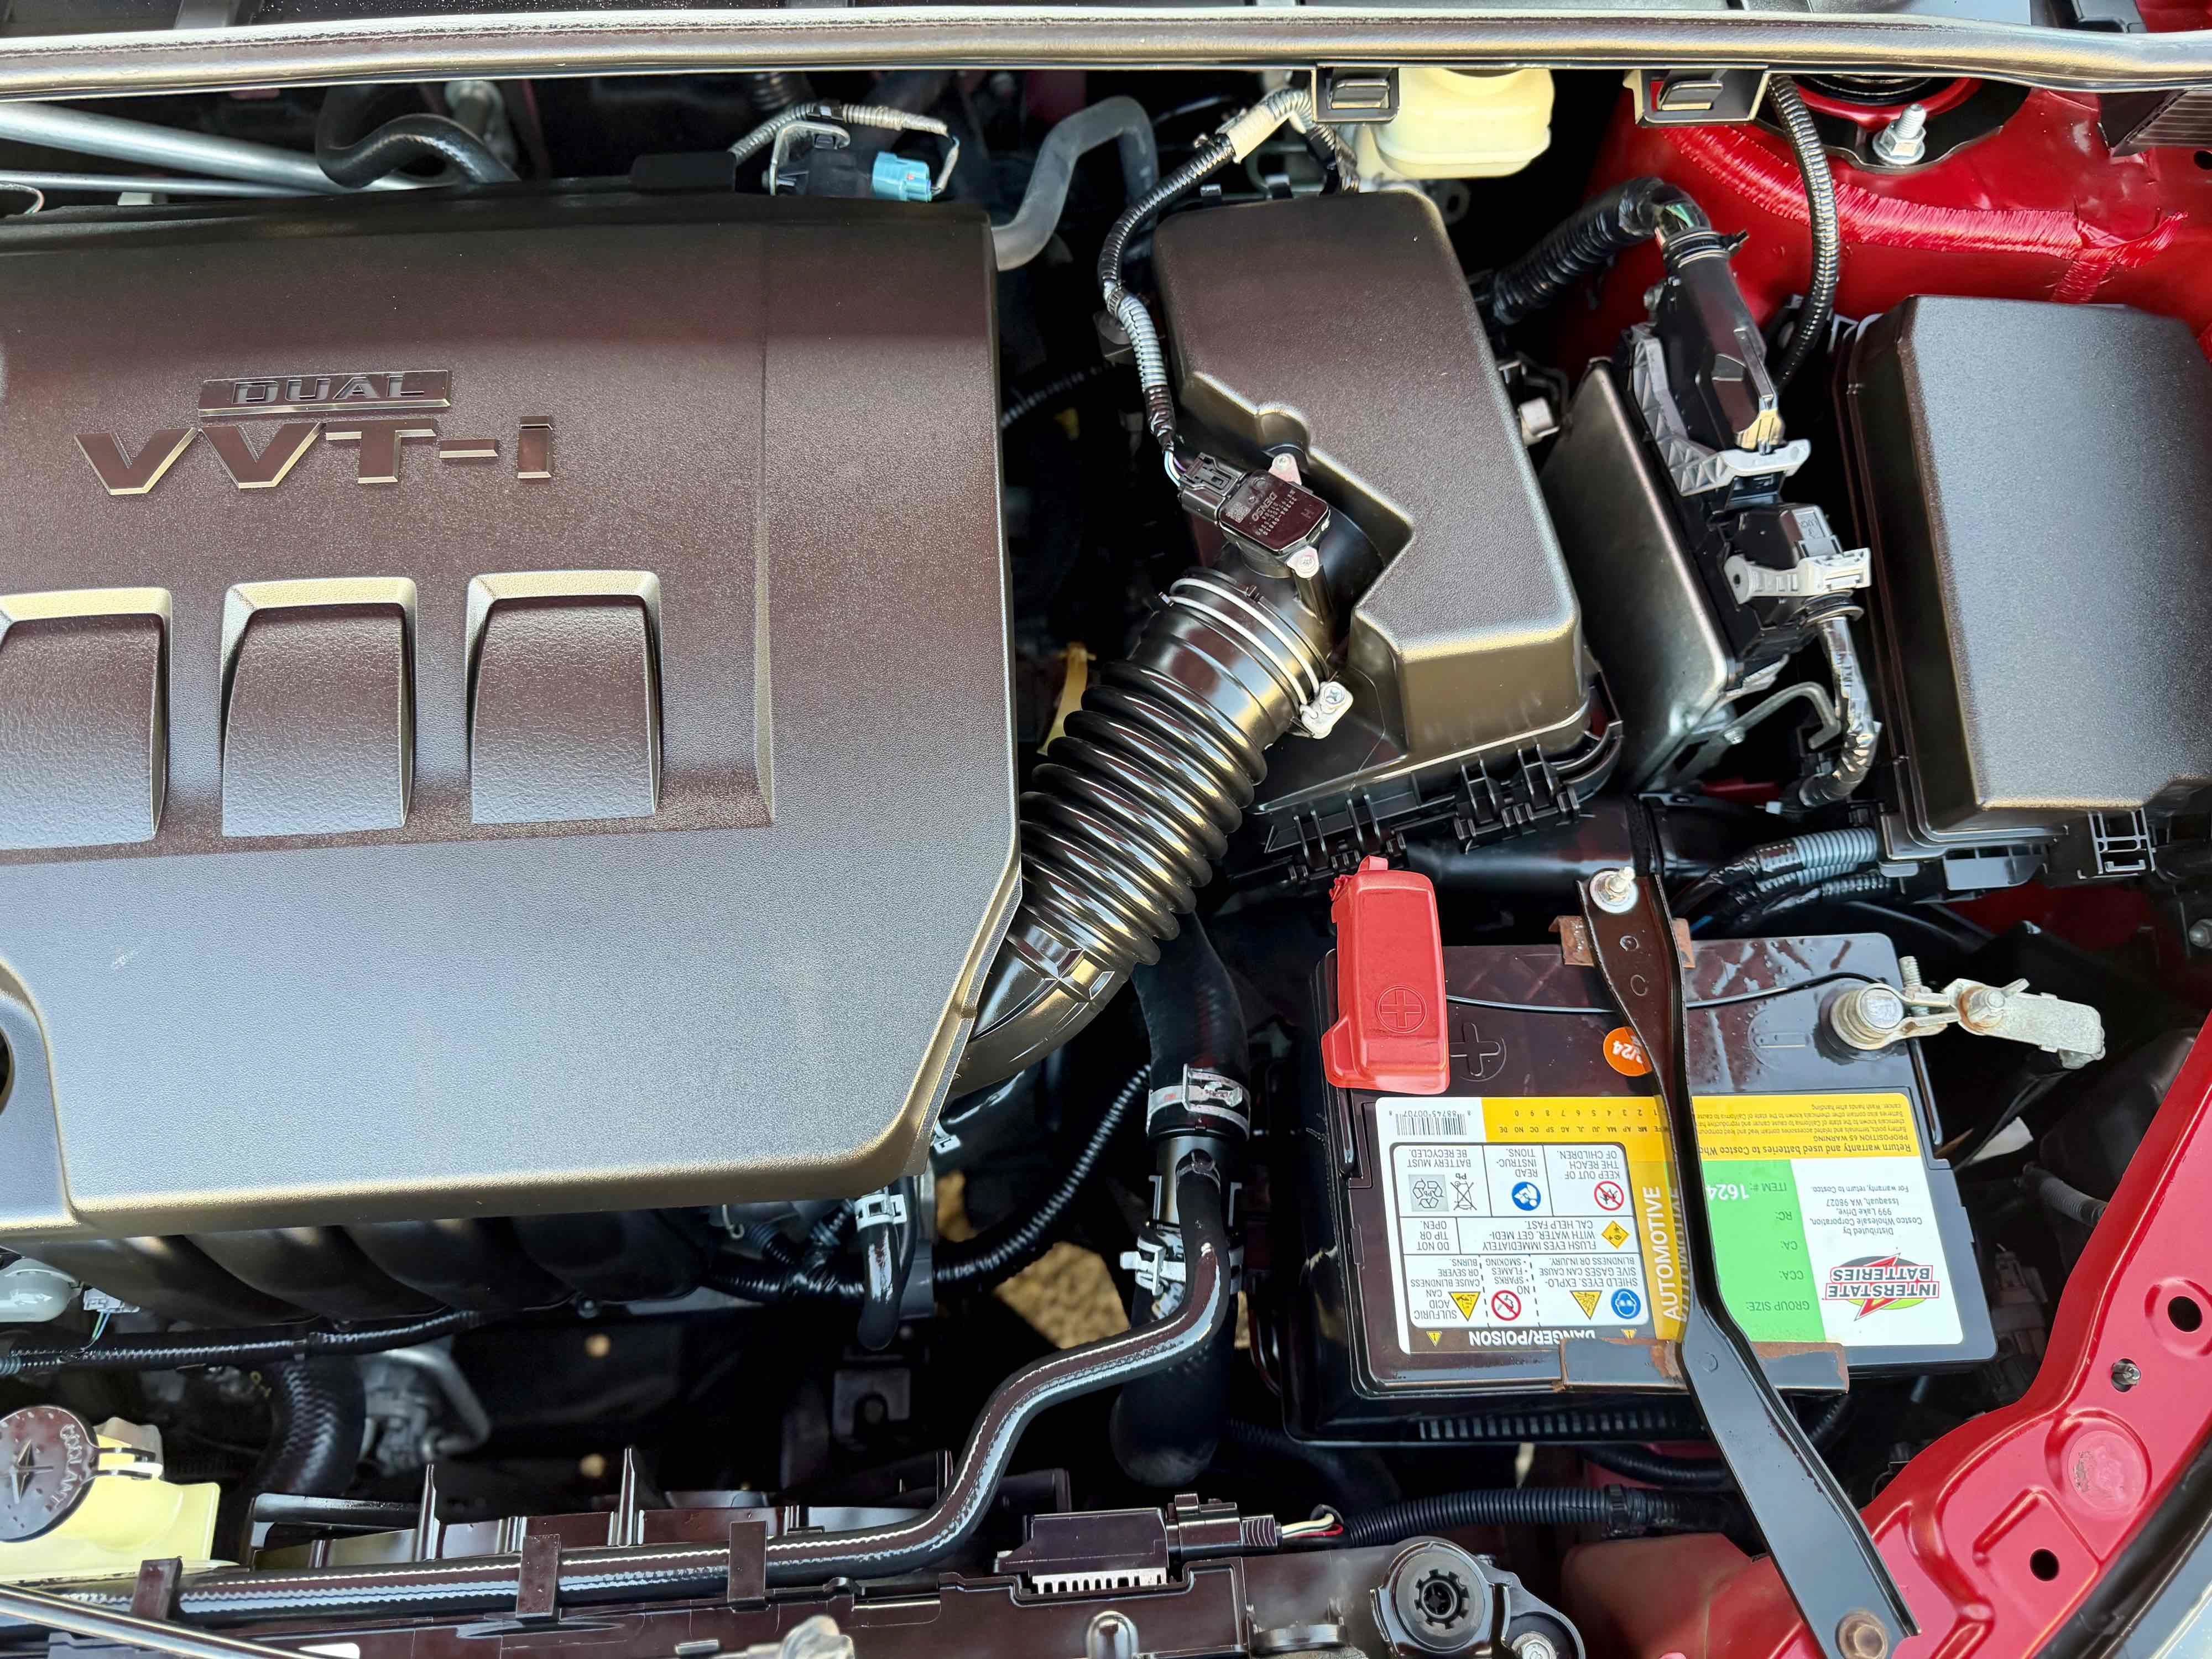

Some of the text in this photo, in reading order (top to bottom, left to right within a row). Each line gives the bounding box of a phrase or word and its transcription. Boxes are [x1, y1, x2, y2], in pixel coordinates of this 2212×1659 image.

[232, 374, 424, 404] DUAL
[1252, 491, 1277, 521] DENSO
[1720, 1146, 1749, 1155] Costco
[1763, 1146, 1801, 1155] batteries
[1803, 1146, 1823, 1155] used
[1825, 1146, 1840, 1154] and
[1844, 1143, 1880, 1152] warranty
[1882, 1144, 1911, 1152] Return
[1408, 1149, 1467, 1158] BE RECYCLED.
[1506, 1149, 1535, 1157] TIONS.
[1557, 1150, 1617, 1159] OF CHILDREN.
[1407, 1159, 1471, 1167] BATTERY MUST
[1496, 1159, 1536, 1167] INSTRUC-
[1569, 1160, 1618, 1169] THE REACH
[1515, 1169, 1538, 1177] READ
[1578, 1171, 1596, 1179] OUT
[1598, 1170, 1620, 1179] KEEP
[1749, 1182, 1759, 1191] #:
[1761, 1182, 1787, 1191] ITEM
[1775, 1211, 1792, 1220] RC:
[1836, 1208, 1856, 1216] Drive,
[1420, 1221, 1447, 1229] OPEN.
[1525, 1220, 1593, 1229] CAL HELP FAST.
[1809, 1217, 1855, 1227] Corporation,
[1420, 1231, 1448, 1240] TIP OR
[1489, 1230, 1595, 1240] WITH WATER. GET MEDI-
[1843, 1227, 1851, 1235] by
[1417, 1242, 1449, 1251] DO NOT
[1483, 1241, 1596, 1251] FLUSH EYES IMMEDIATELY
[1780, 1240, 1797, 1250] CA:
[1642, 1186, 1682, 1322] AUTOMOTIVE
[1592, 1256, 1635, 1265] BLINDNESS
[1540, 1267, 1564, 1276] CAUSE
[1585, 1267, 1615, 1276] GASES
[1616, 1266, 1636, 1276] SIVE
[1778, 1271, 1804, 1280] CCA:
[1833, 1267, 1930, 1281] BATTERIES
[1454, 1279, 1480, 1287] CAUSE
[1545, 1278, 1637, 1287] SHIELD EYES. EXPLO-
[1426, 1289, 1442, 1297] CAN
[1517, 1285, 1530, 1294] NO
[1828, 1284, 1936, 1297] INTERSTATE
[1429, 1300, 1450, 1308] ACID
[1745, 1301, 1809, 1311] GROUP SIZE:
[1413, 1310, 1457, 1319] SULFURIC
[50, 1425, 82, 1508] COOLANT
